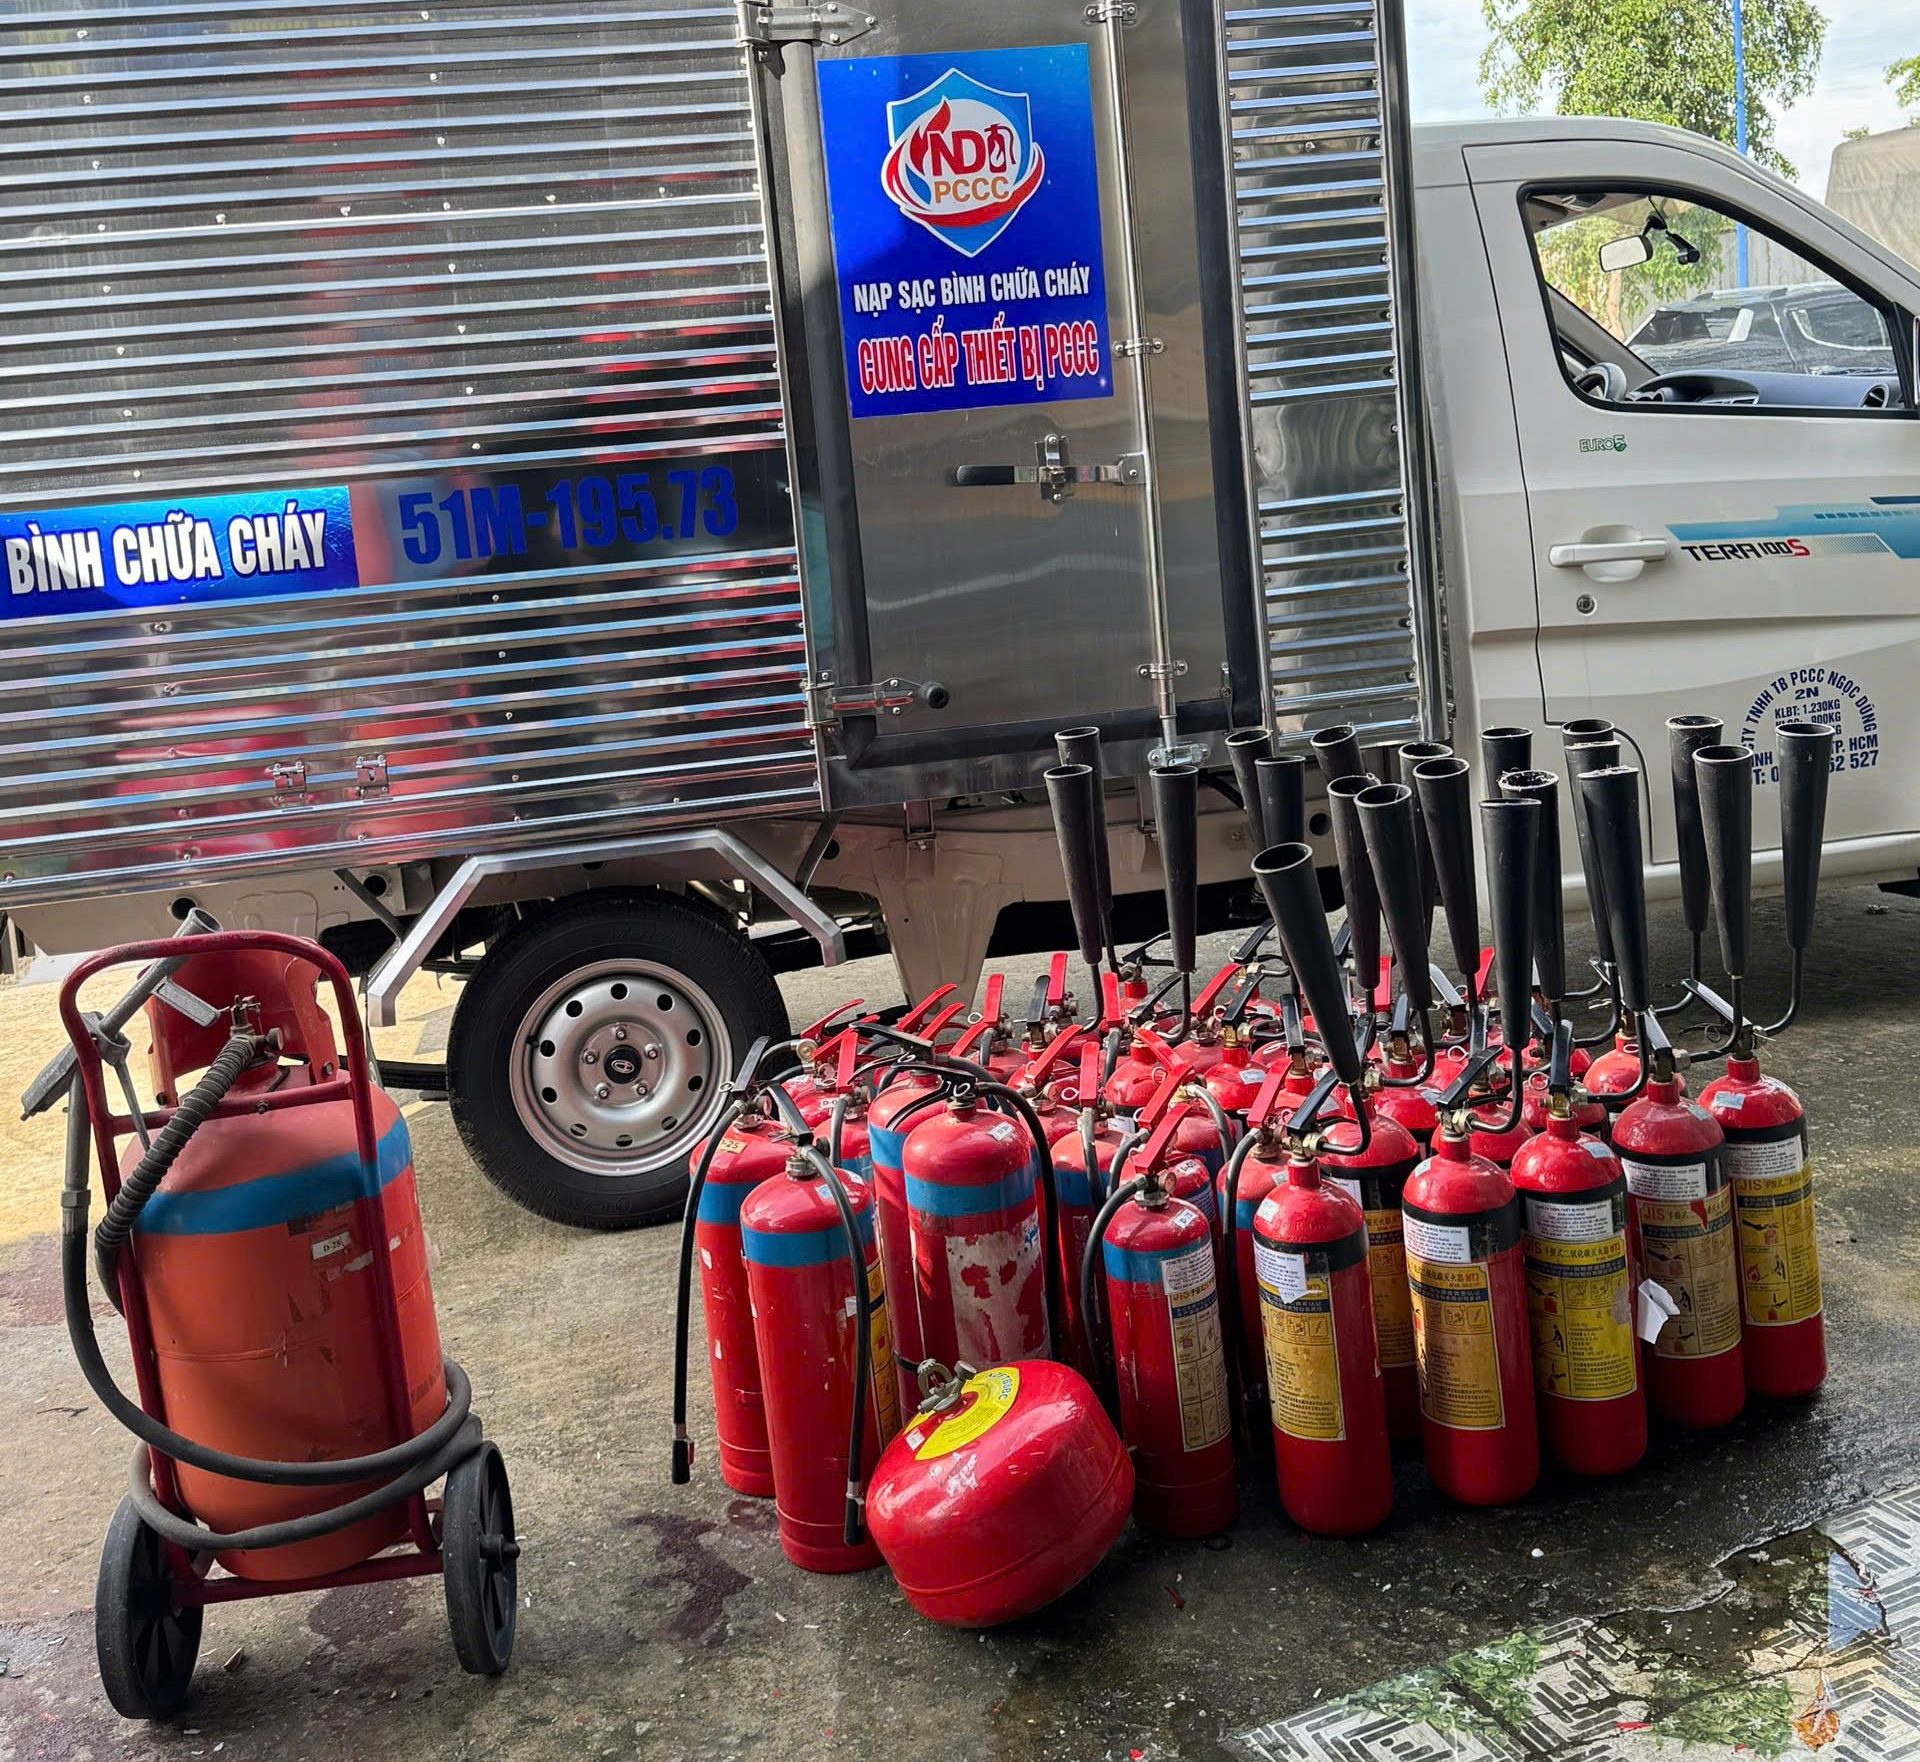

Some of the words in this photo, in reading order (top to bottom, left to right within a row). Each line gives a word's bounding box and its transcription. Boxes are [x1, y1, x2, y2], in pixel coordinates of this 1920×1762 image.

[933, 176, 1010, 204] PCCC
[853, 282, 893, 317] NẠP
[898, 275, 936, 315] SẠC
[941, 270, 985, 306] BÌNH
[990, 266, 1039, 300] CHỮA
[1045, 261, 1091, 296] CHÁY
[858, 335, 915, 395] CUNG
[918, 314, 959, 388] CẤP
[961, 310, 1017, 387] THIẾT
[1021, 324, 1045, 392] BỊ
[1046, 319, 1100, 378] PCCC
[1579, 434, 1627, 453] EURO5
[397, 465, 739, 566] 51M-195.73
[4, 522, 105, 595] BÌNH
[112, 510, 222, 586] CHỮA
[228, 500, 327, 576] CHÁY
[1745, 690, 1775, 724] TNHH
[1771, 676, 1789, 695] TB
[1789, 667, 1825, 687] PCCC
[1827, 670, 1860, 699] NGỌC
[1794, 686, 1819, 700] 2N
[1774, 706, 1800, 720] KLBT:
[1803, 698, 1841, 714] 1.230KG
[1849, 734, 1878, 751] HCM
[1850, 749, 1880, 769] 527
[1643, 1206, 1666, 1221] JIS
